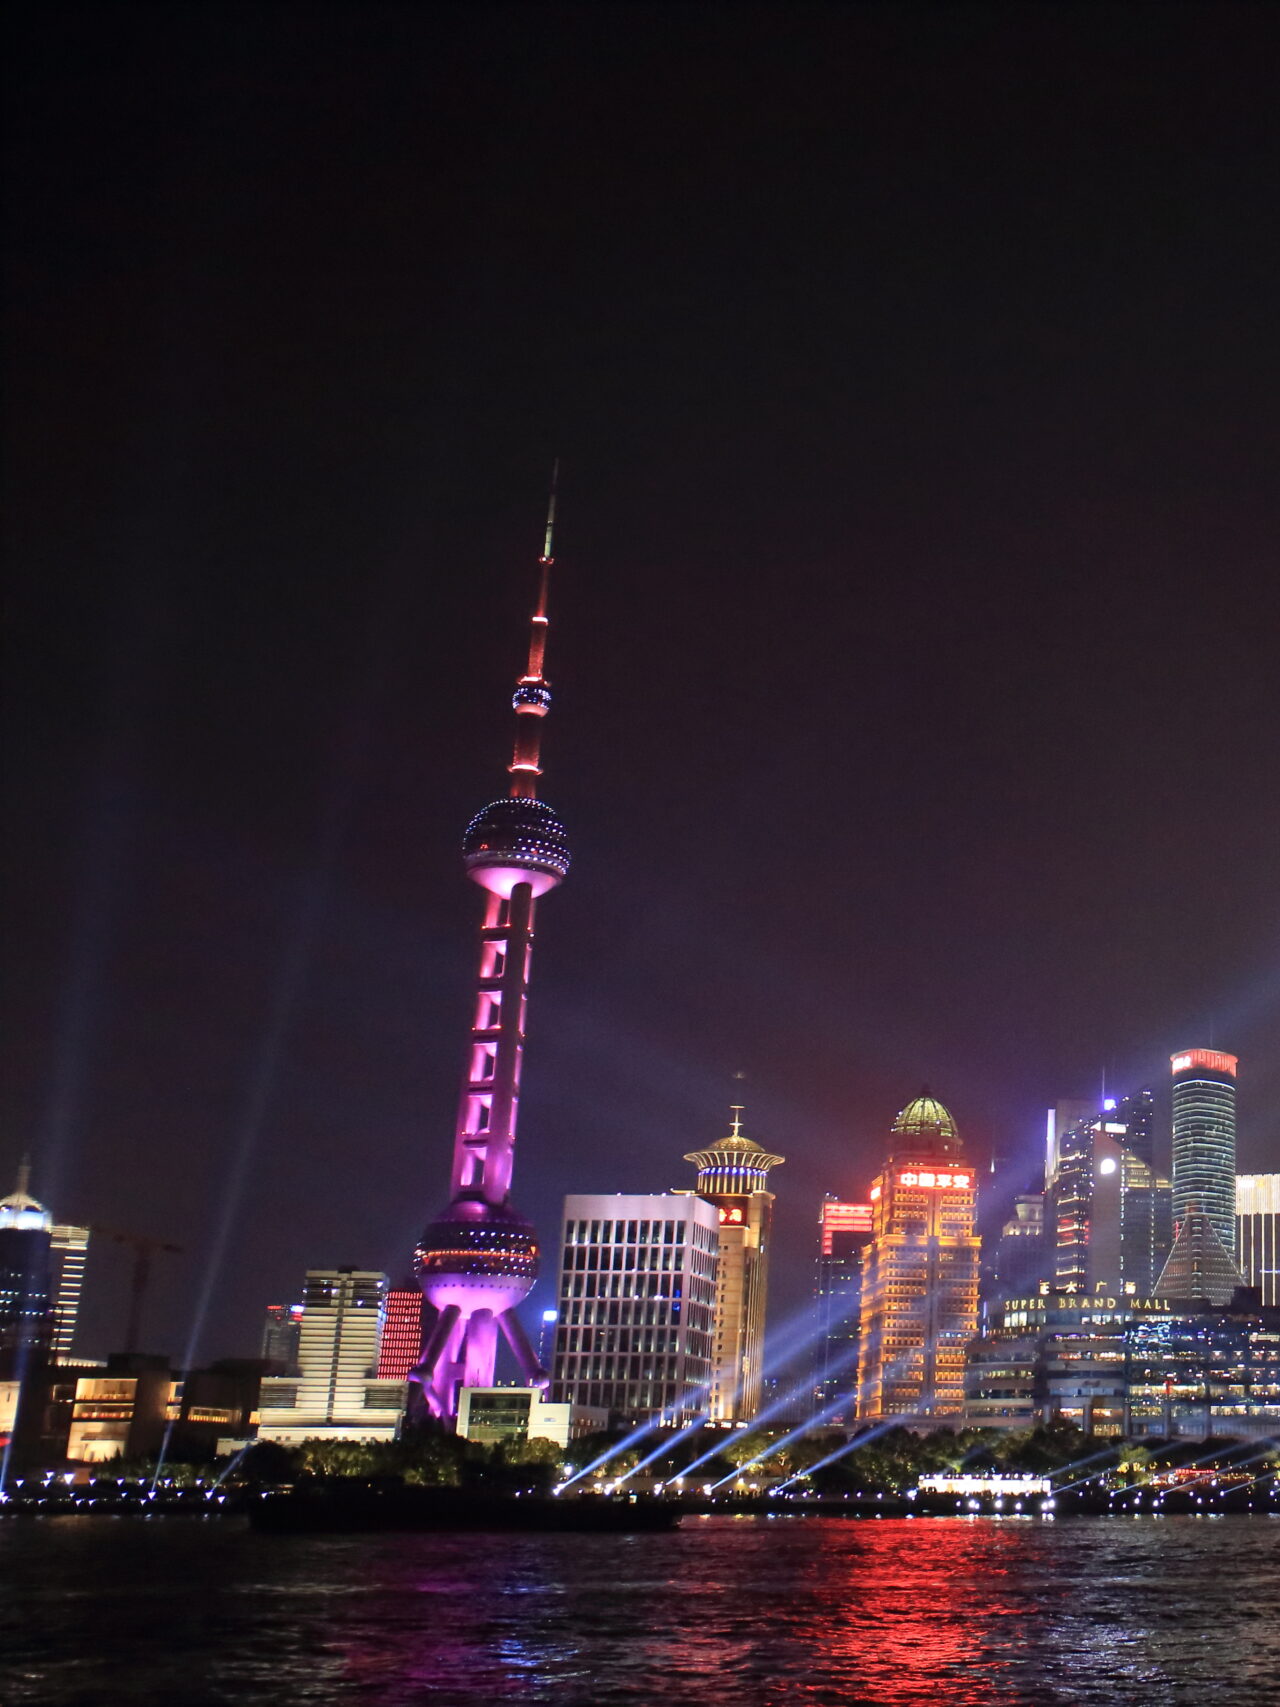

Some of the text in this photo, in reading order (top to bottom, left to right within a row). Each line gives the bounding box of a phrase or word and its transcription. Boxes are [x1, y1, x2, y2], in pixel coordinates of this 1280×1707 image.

[1005, 1298, 1171, 1311] SUPER BRAND MALL
